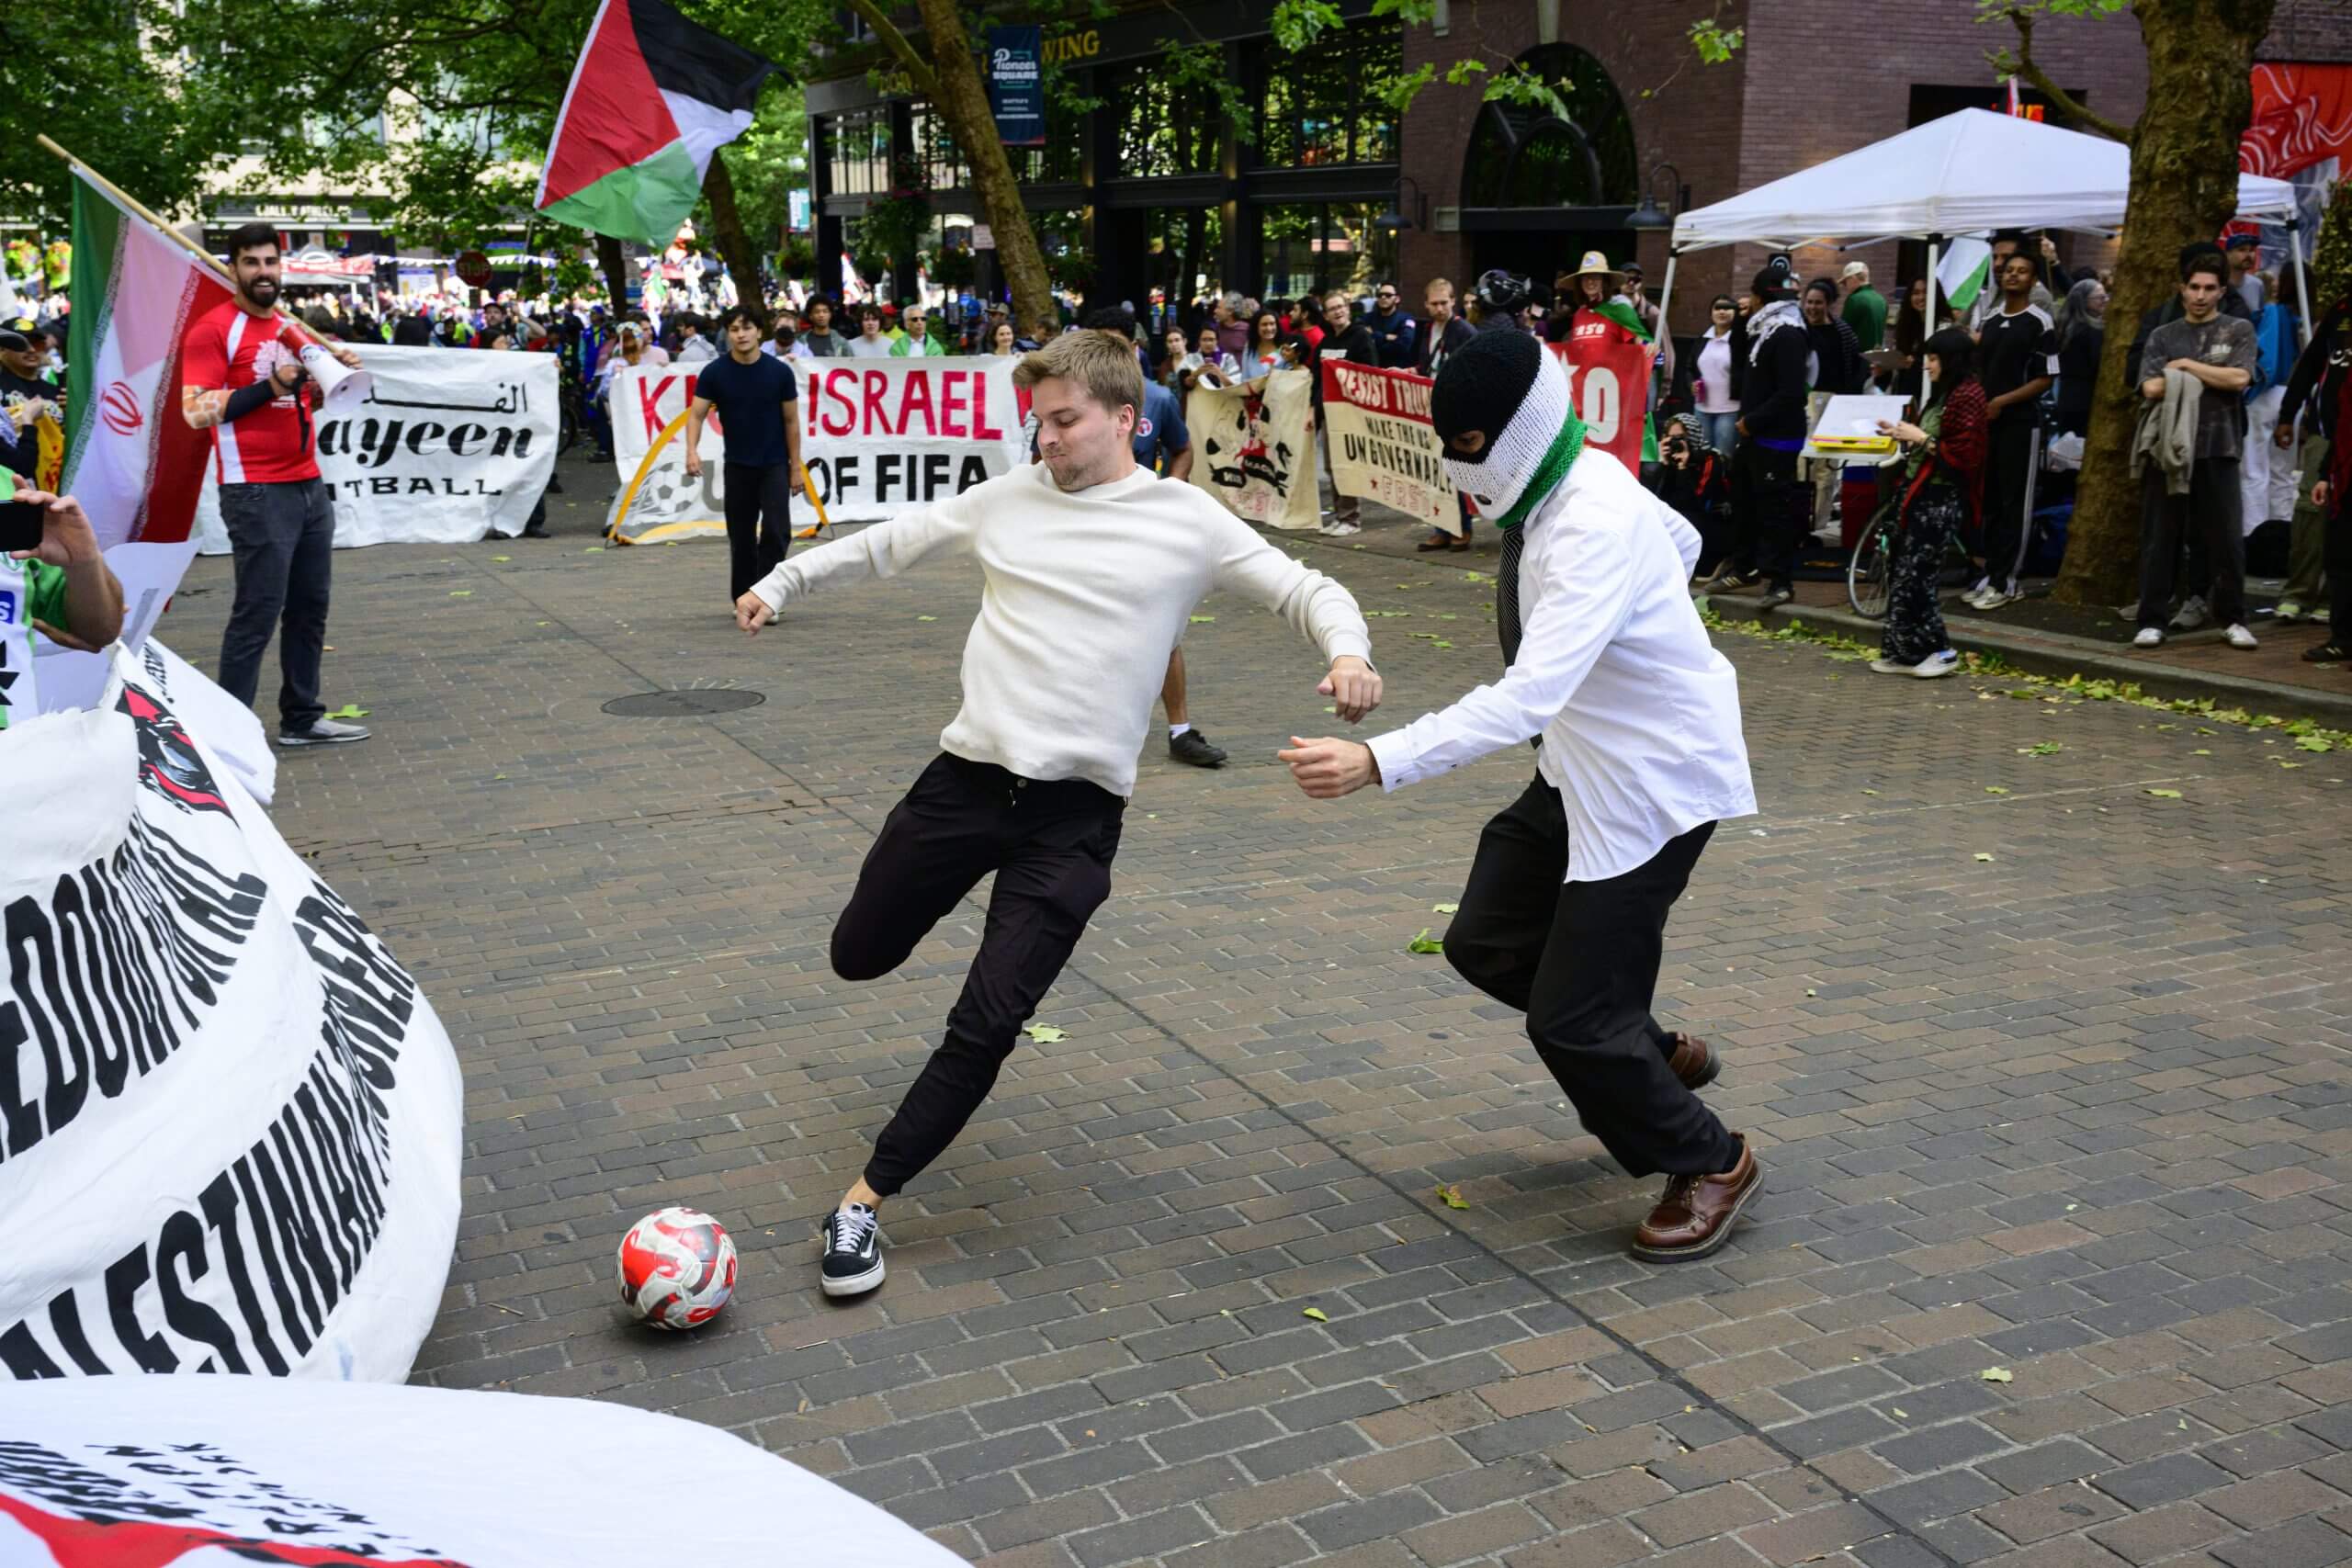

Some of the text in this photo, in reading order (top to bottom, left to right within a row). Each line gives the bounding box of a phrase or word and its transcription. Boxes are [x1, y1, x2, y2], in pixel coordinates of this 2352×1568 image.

[992, 48, 1036, 70] Pioneer
[992, 71, 1038, 81] SQUARE
[1336, 367, 1388, 410] RESIST
[1365, 416, 1394, 441] MAKE
[1396, 423, 1416, 446] THE
[805, 454, 989, 505] OF FIFA
[0, 858, 181, 1164] EDOM
